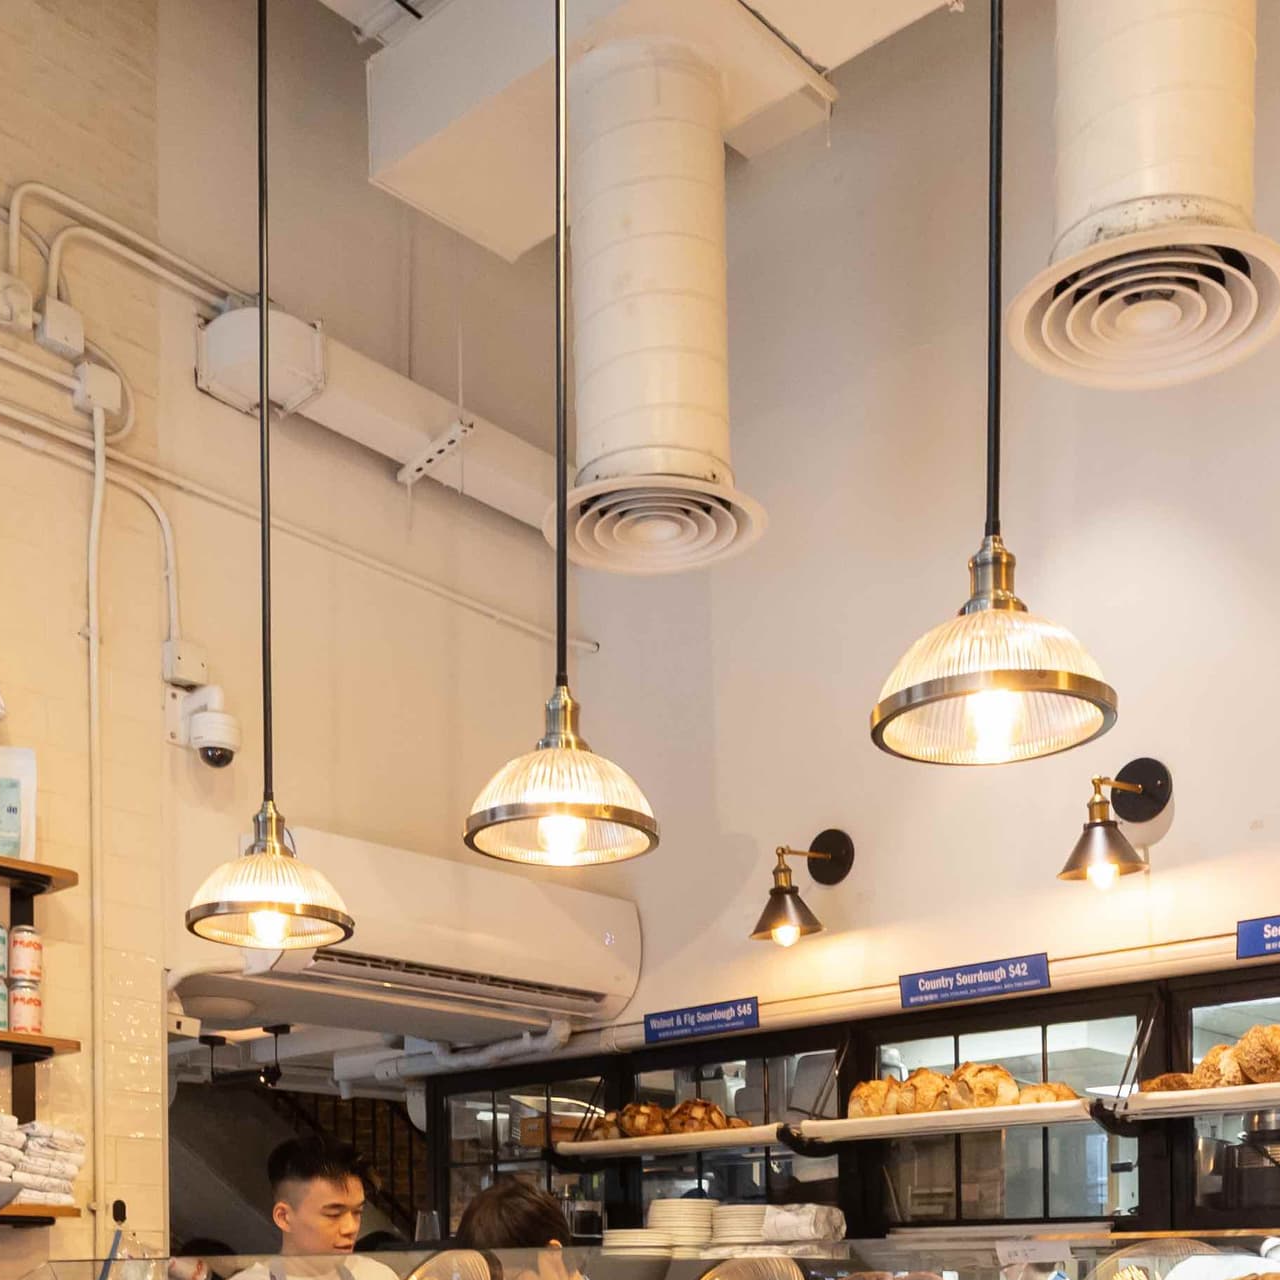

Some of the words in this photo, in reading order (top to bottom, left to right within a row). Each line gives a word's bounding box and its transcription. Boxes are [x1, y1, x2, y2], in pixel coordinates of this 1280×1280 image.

[918, 975, 954, 991] Country
[956, 966, 1007, 986] Sourdough
[1008, 962, 1029, 978] $42
[650, 1017, 674, 1030] Walnut
[683, 1013, 695, 1026] Fig
[696, 1007, 736, 1022] Sourdough
[737, 1003, 752, 1017] $45
